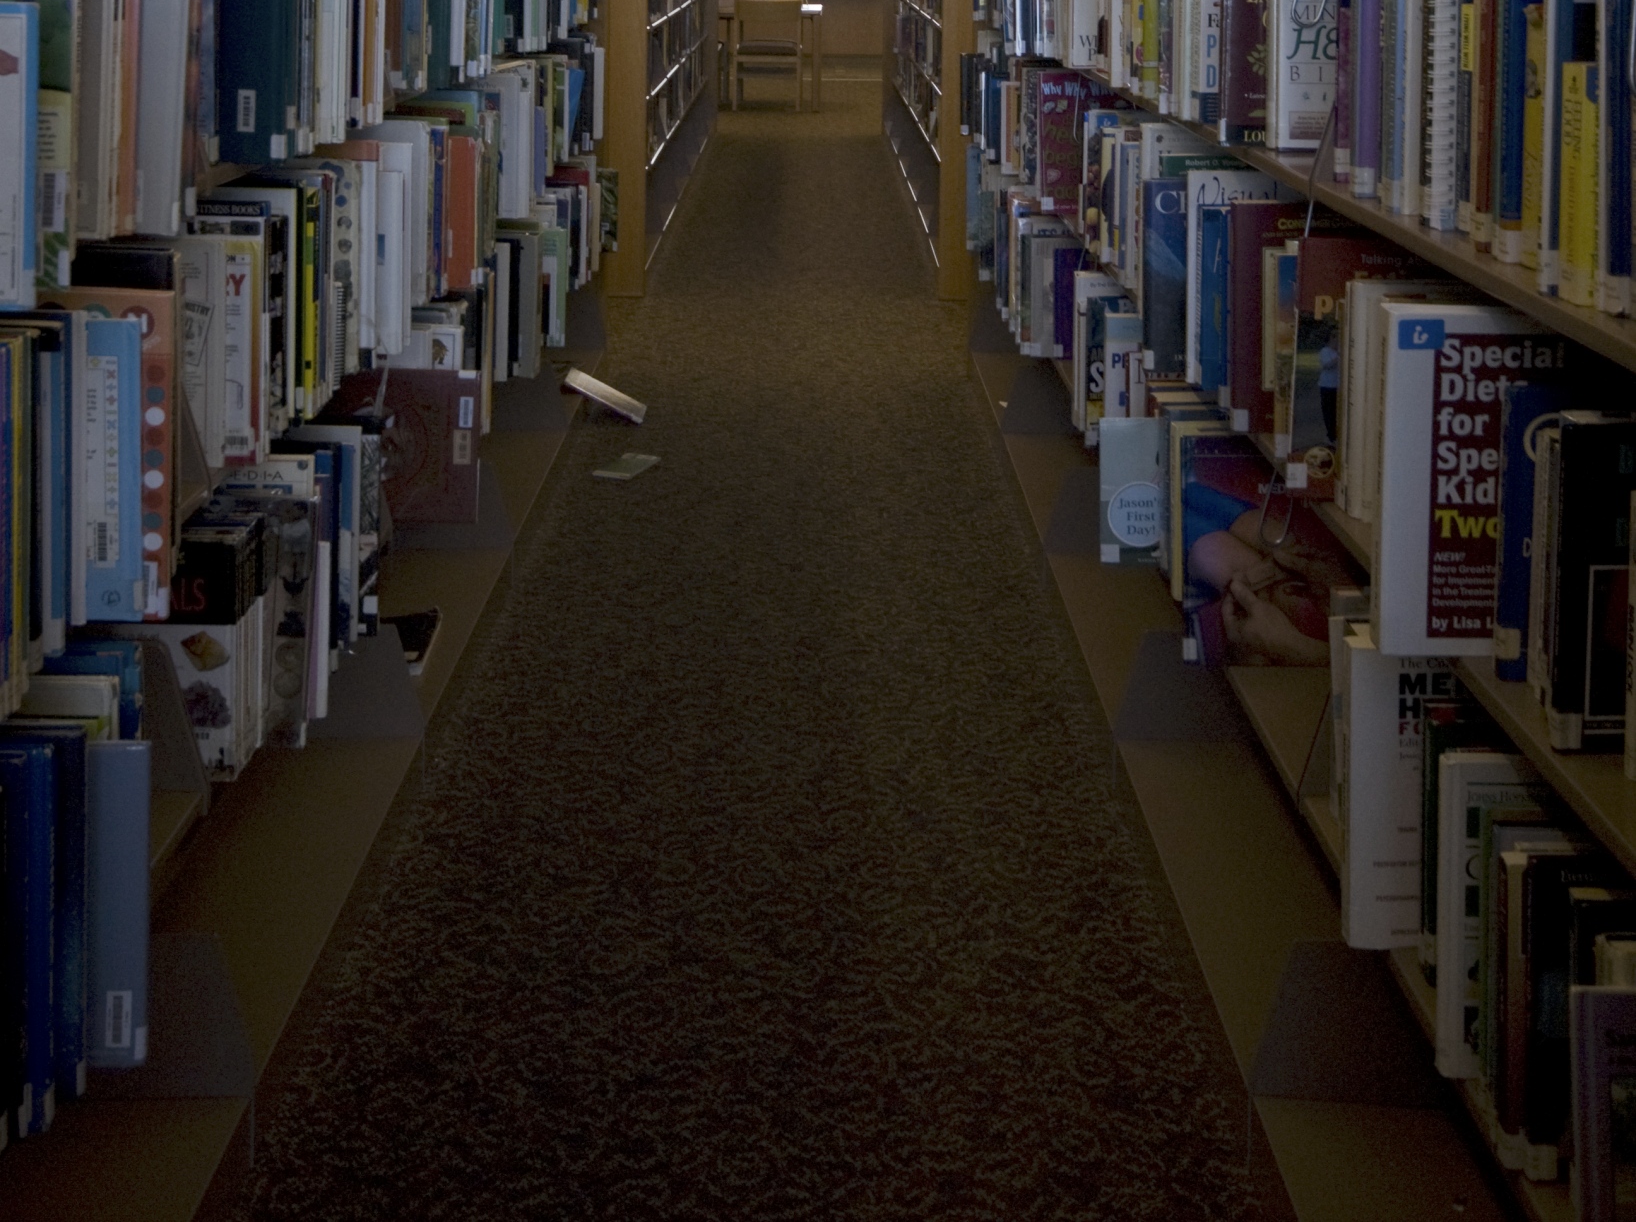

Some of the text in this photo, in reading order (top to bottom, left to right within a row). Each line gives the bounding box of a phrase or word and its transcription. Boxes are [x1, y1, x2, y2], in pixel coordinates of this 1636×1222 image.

[1041, 81, 1062, 95] Why
[1185, 159, 1210, 167] Robert
[231, 204, 261, 215] BOOKS
[1360, 253, 1403, 267] Talking
[1439, 337, 1565, 376] Special
[1439, 372, 1529, 402] Diet
[1436, 406, 1490, 438] for
[1436, 440, 1499, 479] Spe
[1436, 474, 1497, 505] Kid
[1127, 511, 1155, 521] First
[1127, 524, 1156, 536] Day!
[1432, 564, 1457, 574] More
[1431, 615, 1449, 633] by
[1452, 615, 1481, 629] Lisa
[1400, 658, 1422, 668] The
